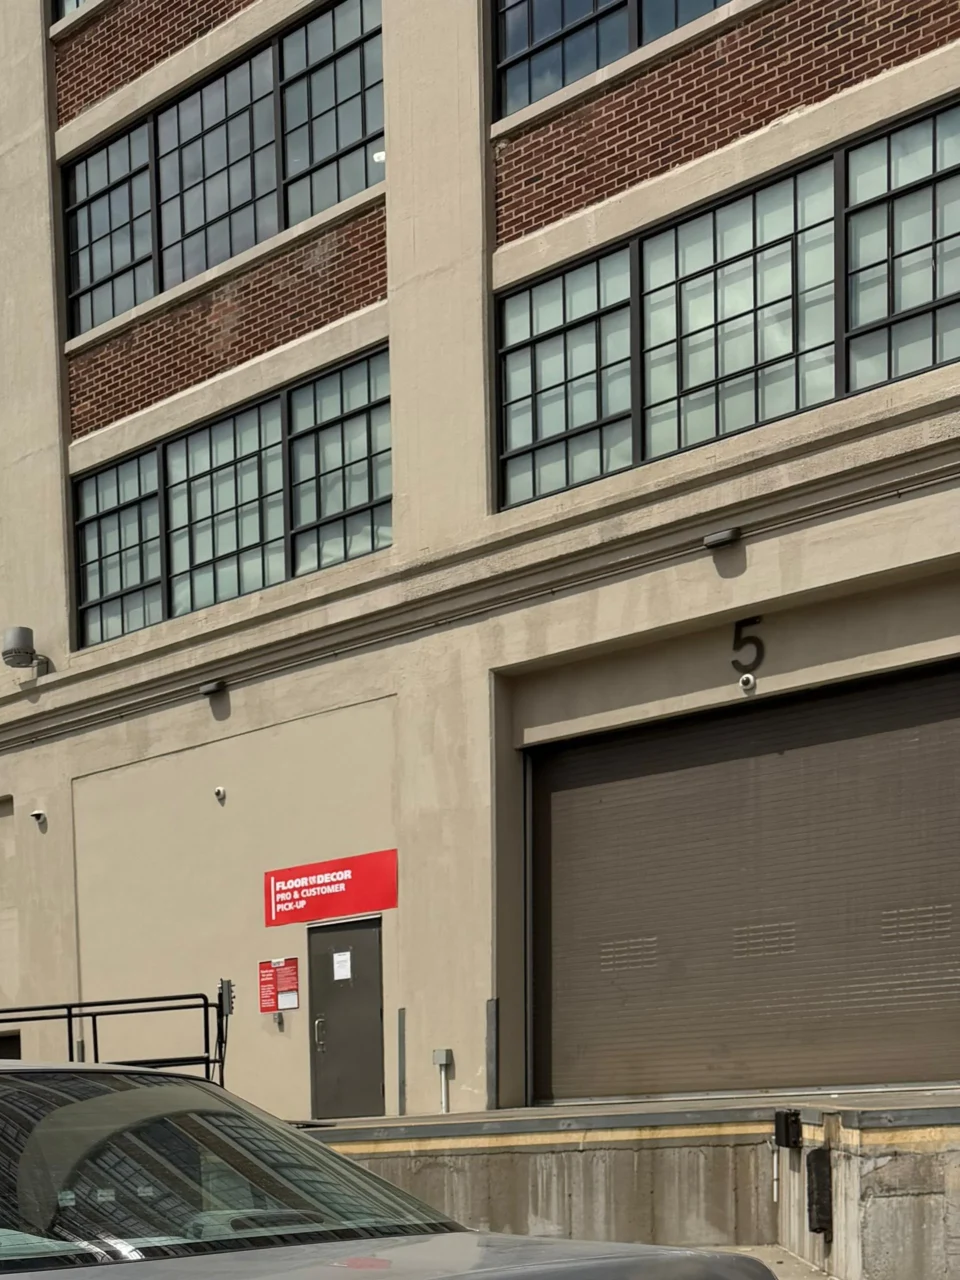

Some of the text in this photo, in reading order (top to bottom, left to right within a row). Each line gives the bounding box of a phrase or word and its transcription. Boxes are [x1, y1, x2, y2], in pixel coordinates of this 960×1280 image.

[731, 615, 765, 674] 5
[276, 883, 346, 902] PRO & CUSTOMER
[276, 900, 307, 912] PICK-UP
